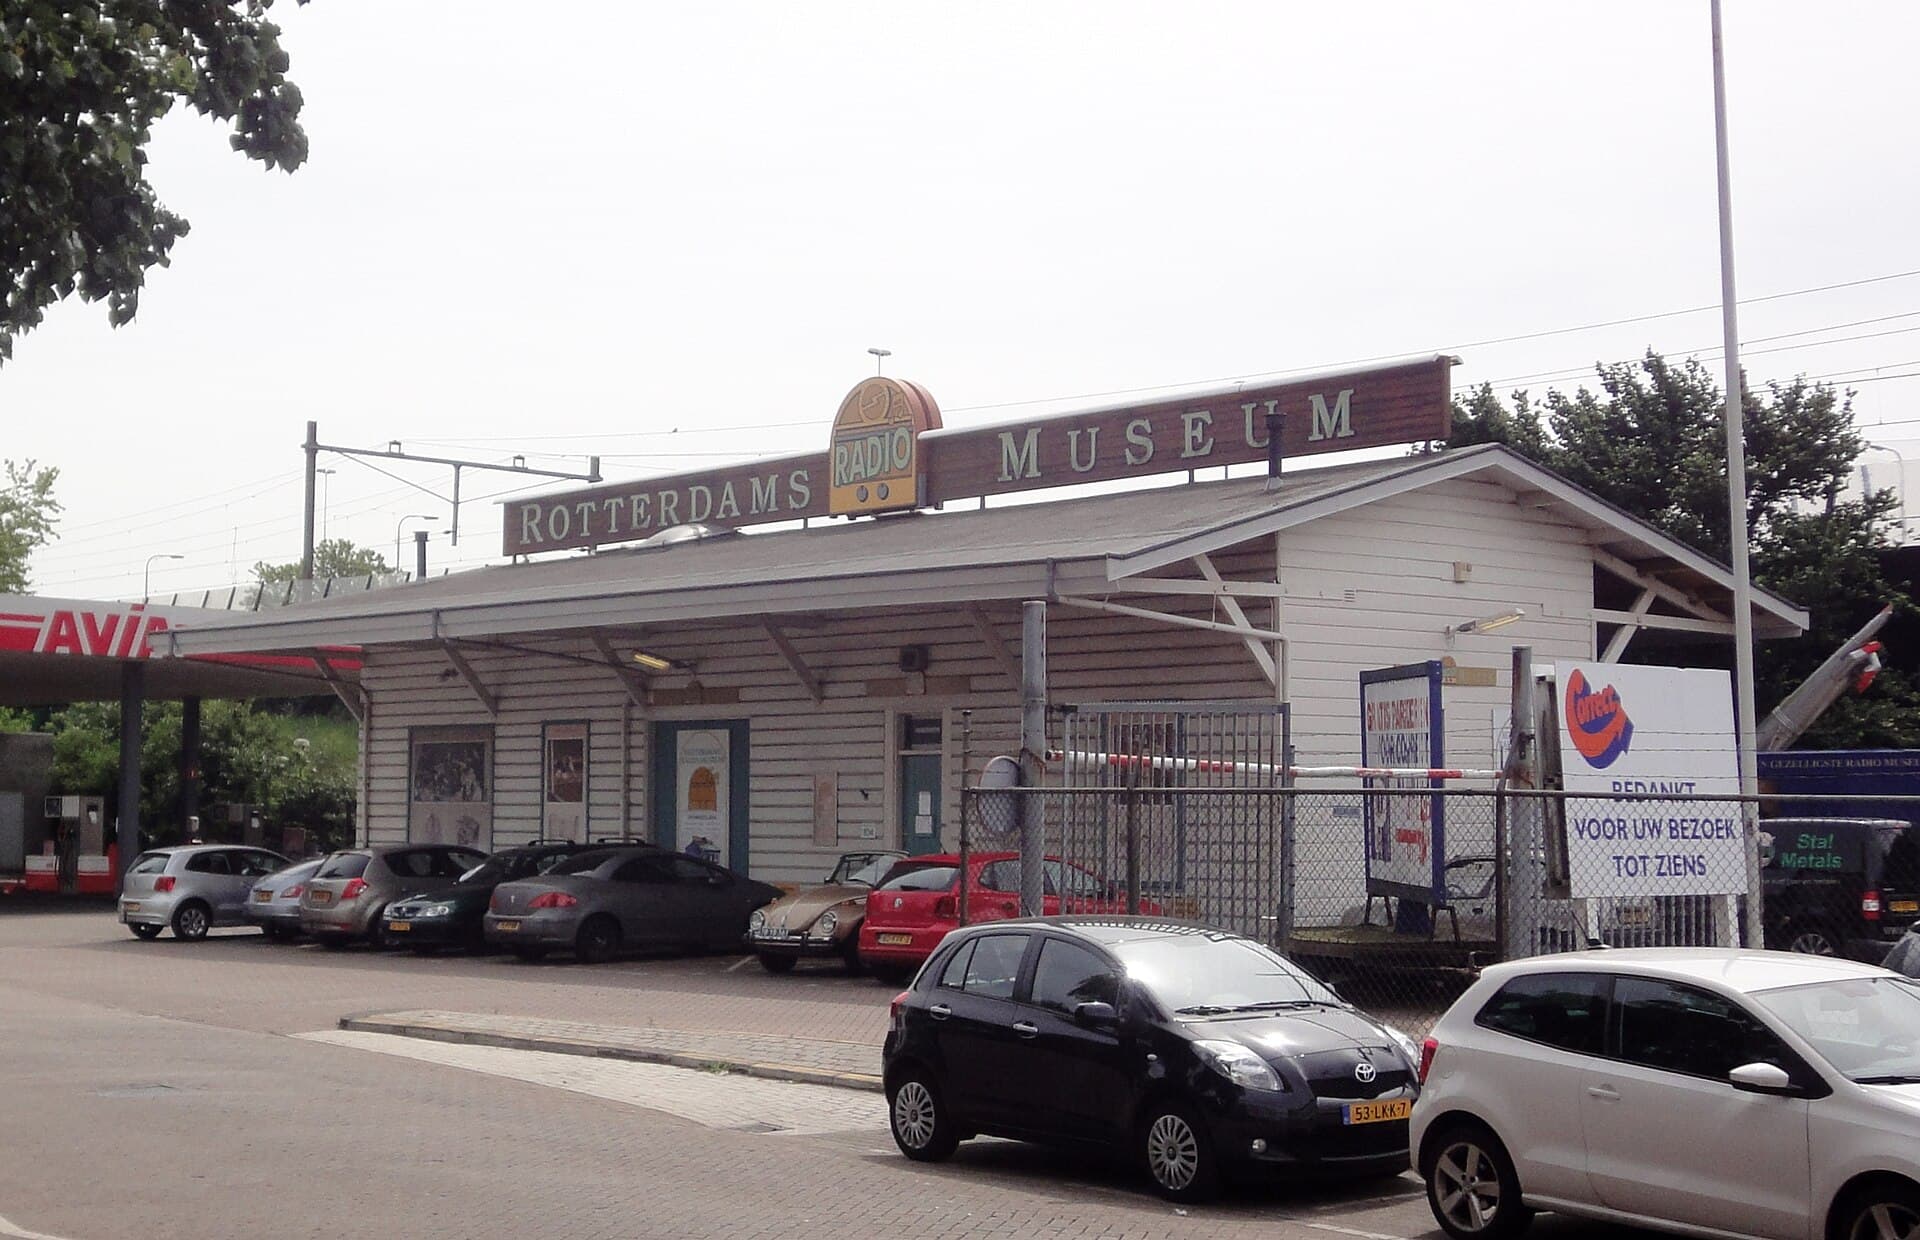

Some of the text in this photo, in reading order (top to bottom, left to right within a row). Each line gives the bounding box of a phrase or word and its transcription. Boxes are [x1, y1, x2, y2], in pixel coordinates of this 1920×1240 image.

[519, 389, 1355, 545] ROTTERDAMS MUSEUM
[834, 426, 911, 488] RADIO
[1845, 757, 1882, 768] RADIO
[1612, 781, 1697, 804] BEDANKT
[1574, 818, 1737, 841] VOOR UW BEZOEK
[1797, 833, 1834, 850] Stal
[1612, 854, 1707, 877] TOT ZIENS
[1780, 852, 1843, 868] Metals
